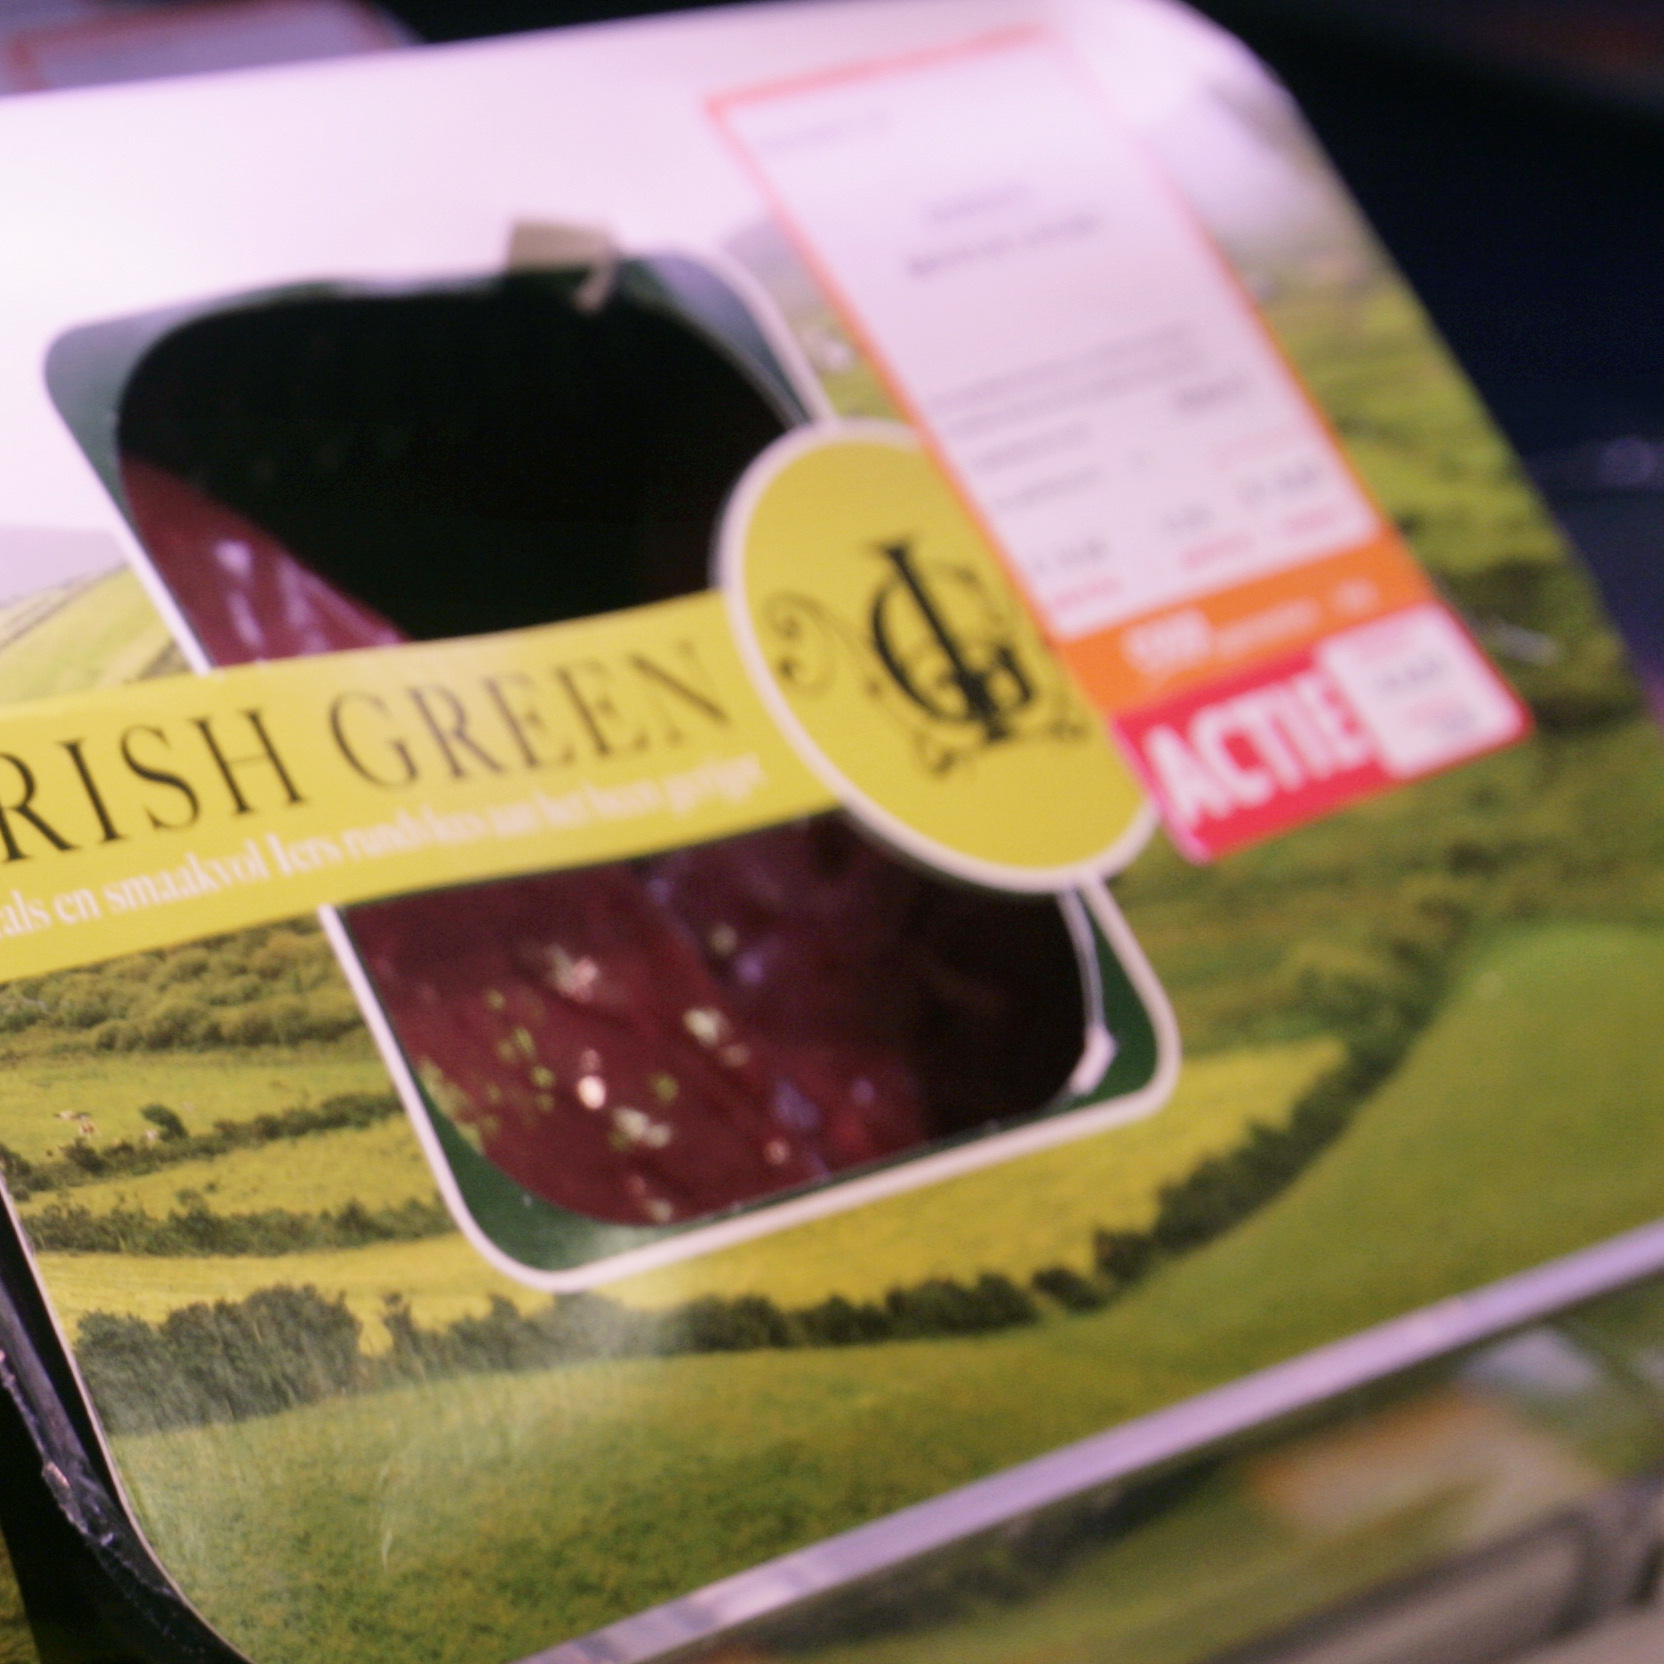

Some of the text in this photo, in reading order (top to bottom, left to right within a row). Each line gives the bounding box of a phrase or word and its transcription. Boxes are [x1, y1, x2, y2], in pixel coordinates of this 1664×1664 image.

[324, 635, 739, 796] GREEN
[54, 887, 102, 925] en
[102, 838, 271, 914] smaakvol
